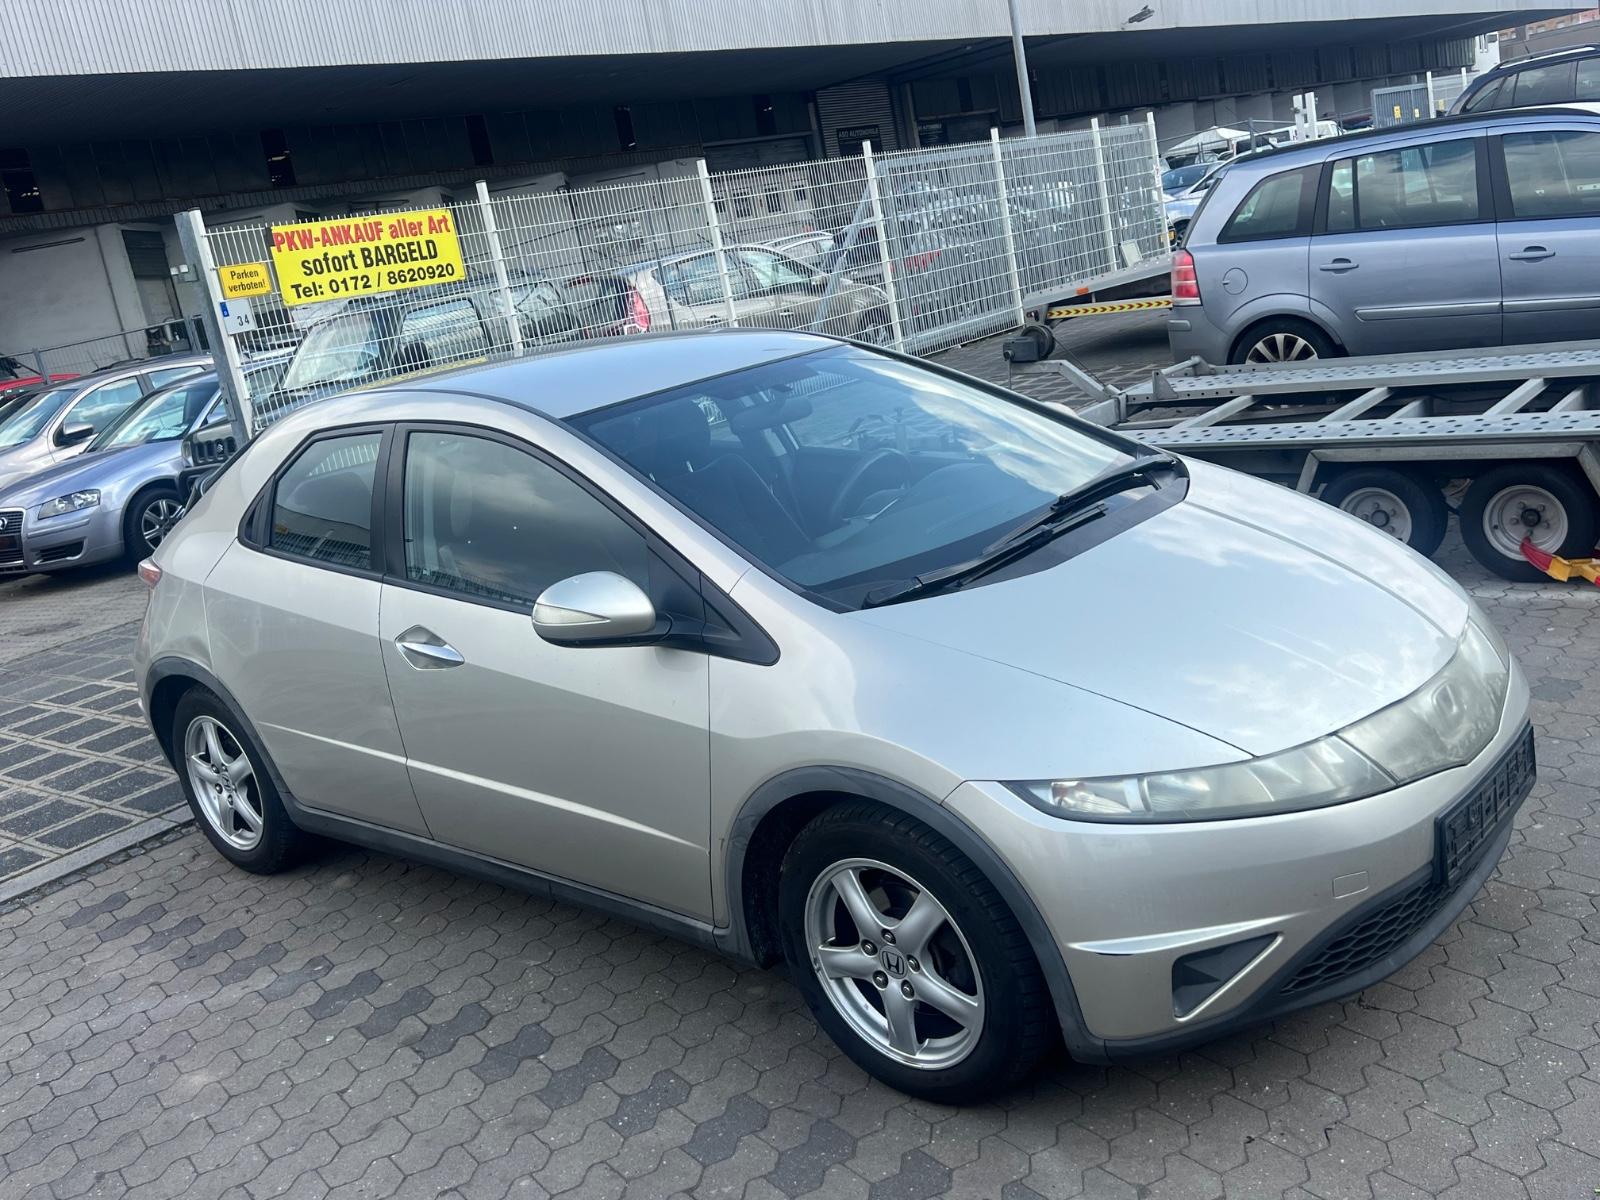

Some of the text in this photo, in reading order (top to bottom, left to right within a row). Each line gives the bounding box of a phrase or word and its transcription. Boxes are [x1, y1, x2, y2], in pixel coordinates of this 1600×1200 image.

[272, 215, 451, 253] PKW-ANKAUF aller Art
[301, 239, 438, 276] sofort BARGELD
[228, 279, 266, 292] verboten!
[230, 269, 259, 280] Parken
[290, 281, 324, 299] Tel:
[329, 274, 372, 293] 0172
[387, 263, 455, 285] 8620920
[236, 314, 250, 327] 34
